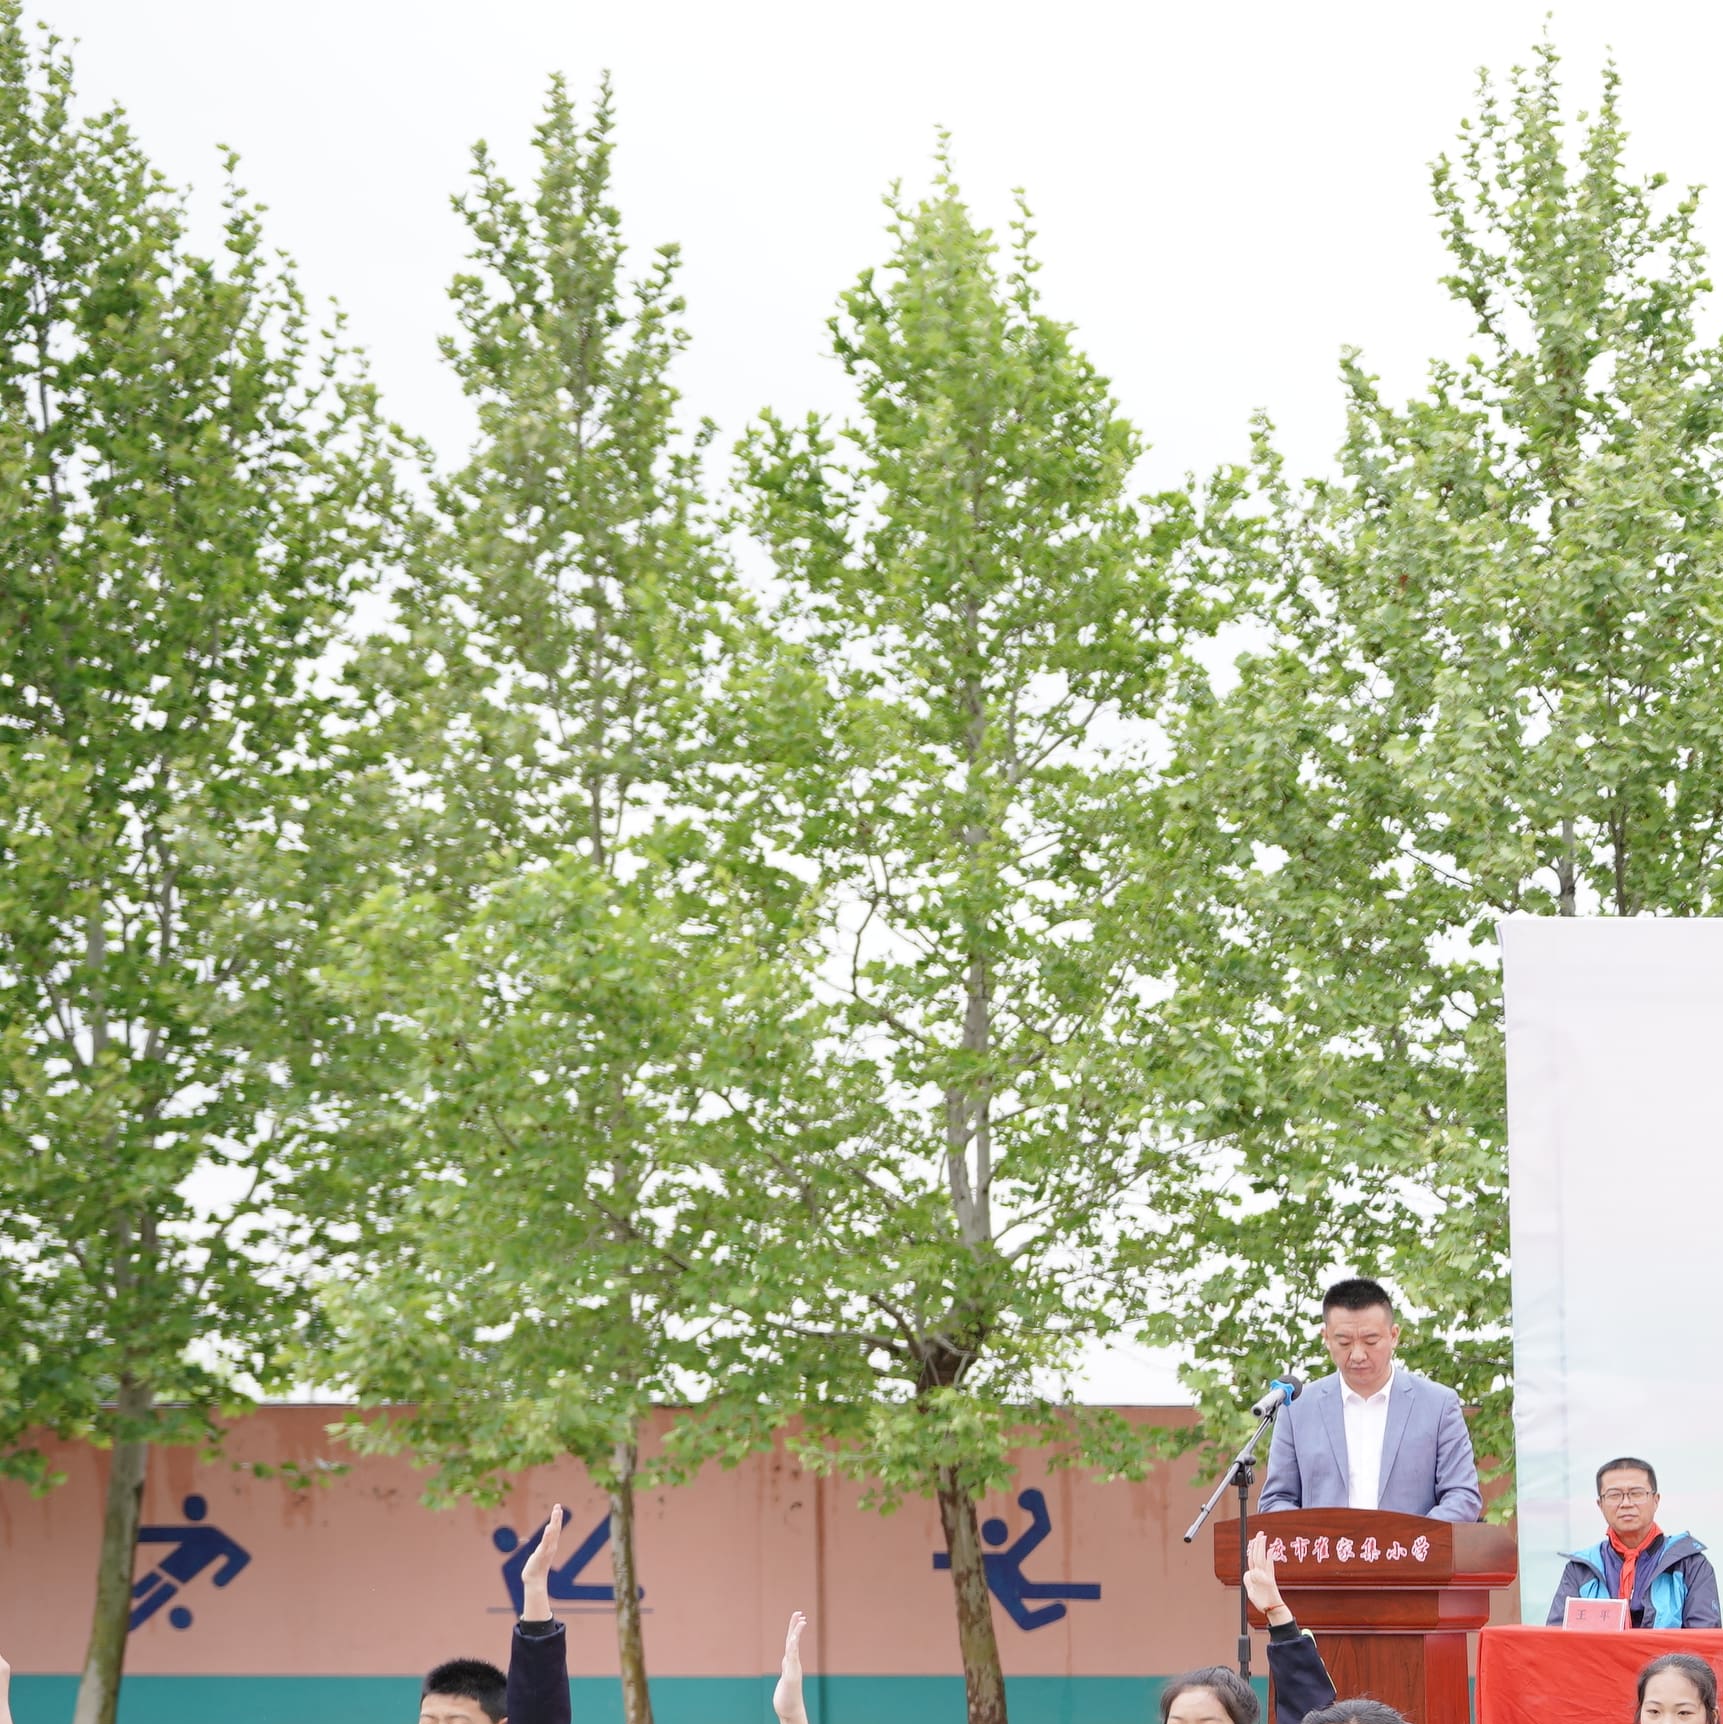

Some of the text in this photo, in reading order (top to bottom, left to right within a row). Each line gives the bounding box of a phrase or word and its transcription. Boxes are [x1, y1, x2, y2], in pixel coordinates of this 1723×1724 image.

[1247, 1535, 1430, 1563] 度市崔家集小学
